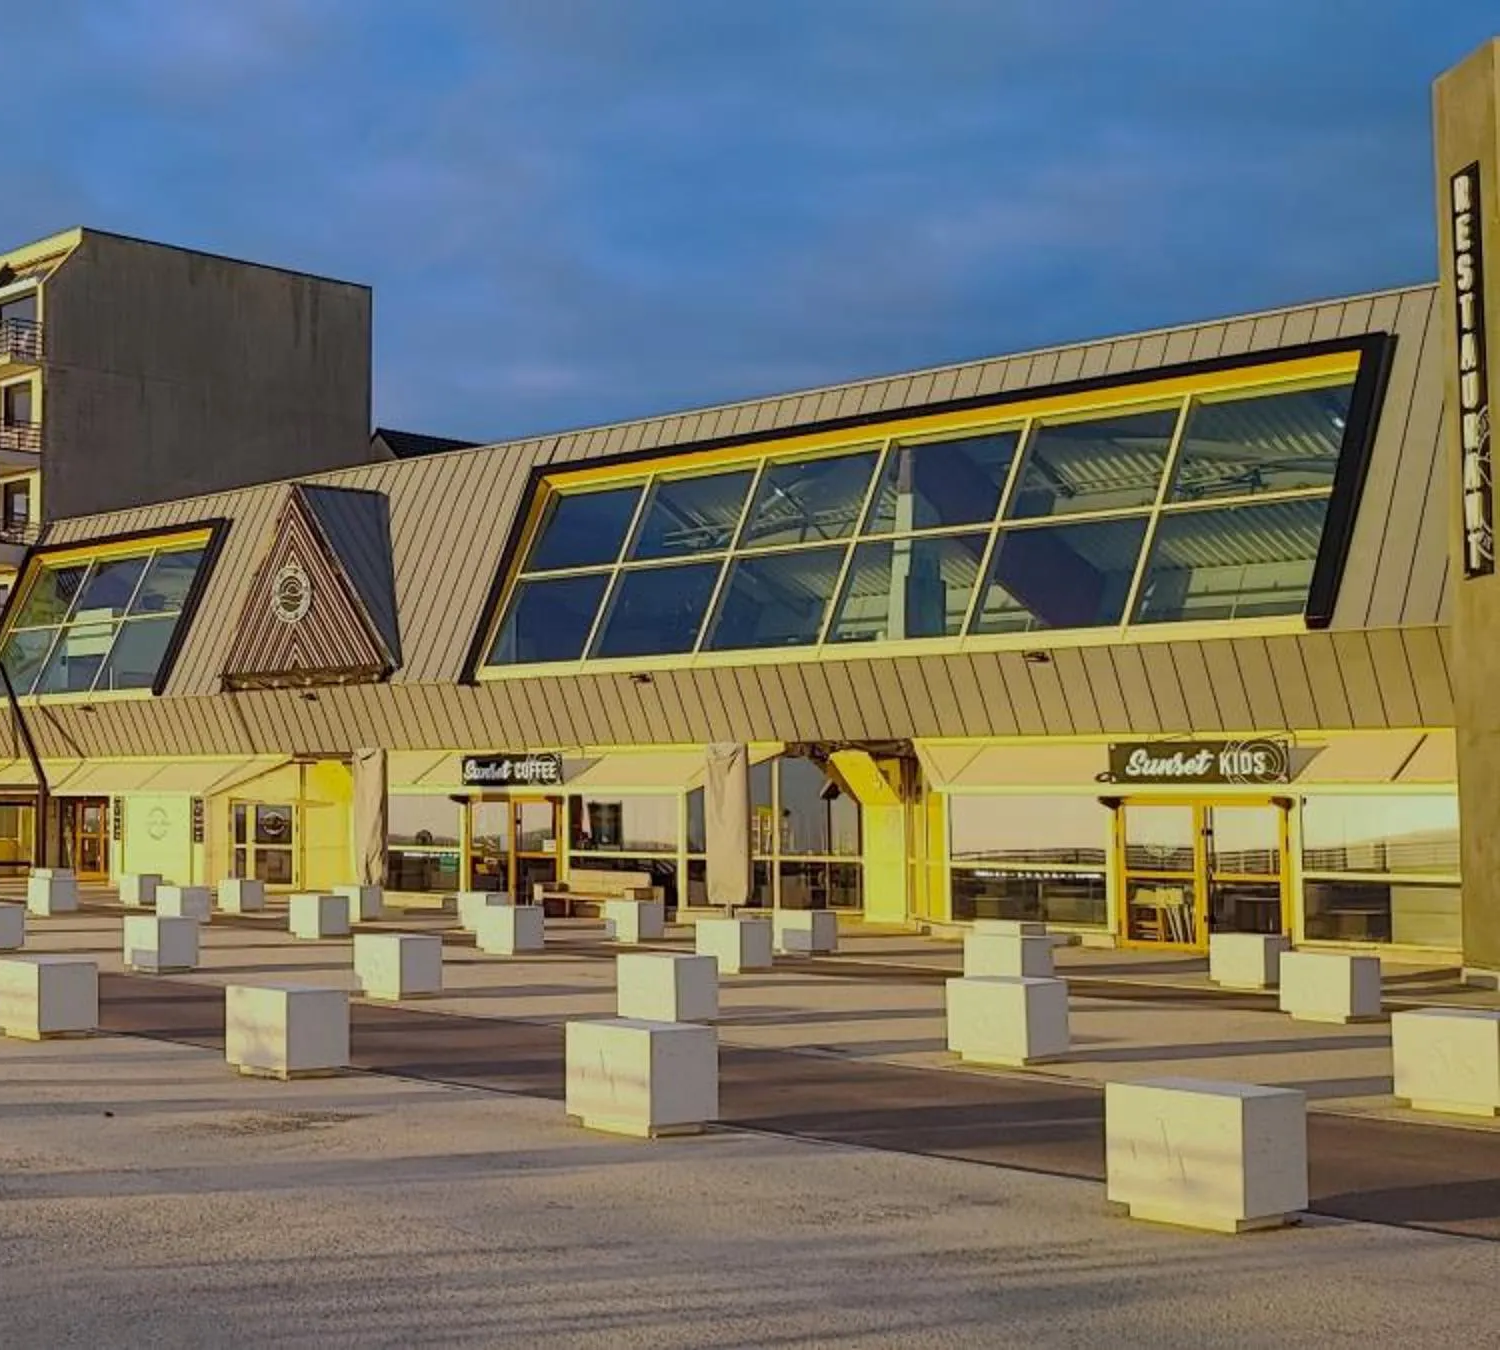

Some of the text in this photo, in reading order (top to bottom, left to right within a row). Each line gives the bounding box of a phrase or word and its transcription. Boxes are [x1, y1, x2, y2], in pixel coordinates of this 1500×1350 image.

[463, 758, 557, 781] Sunset COFFEE
[1125, 748, 1267, 777] Sunset KIDS
